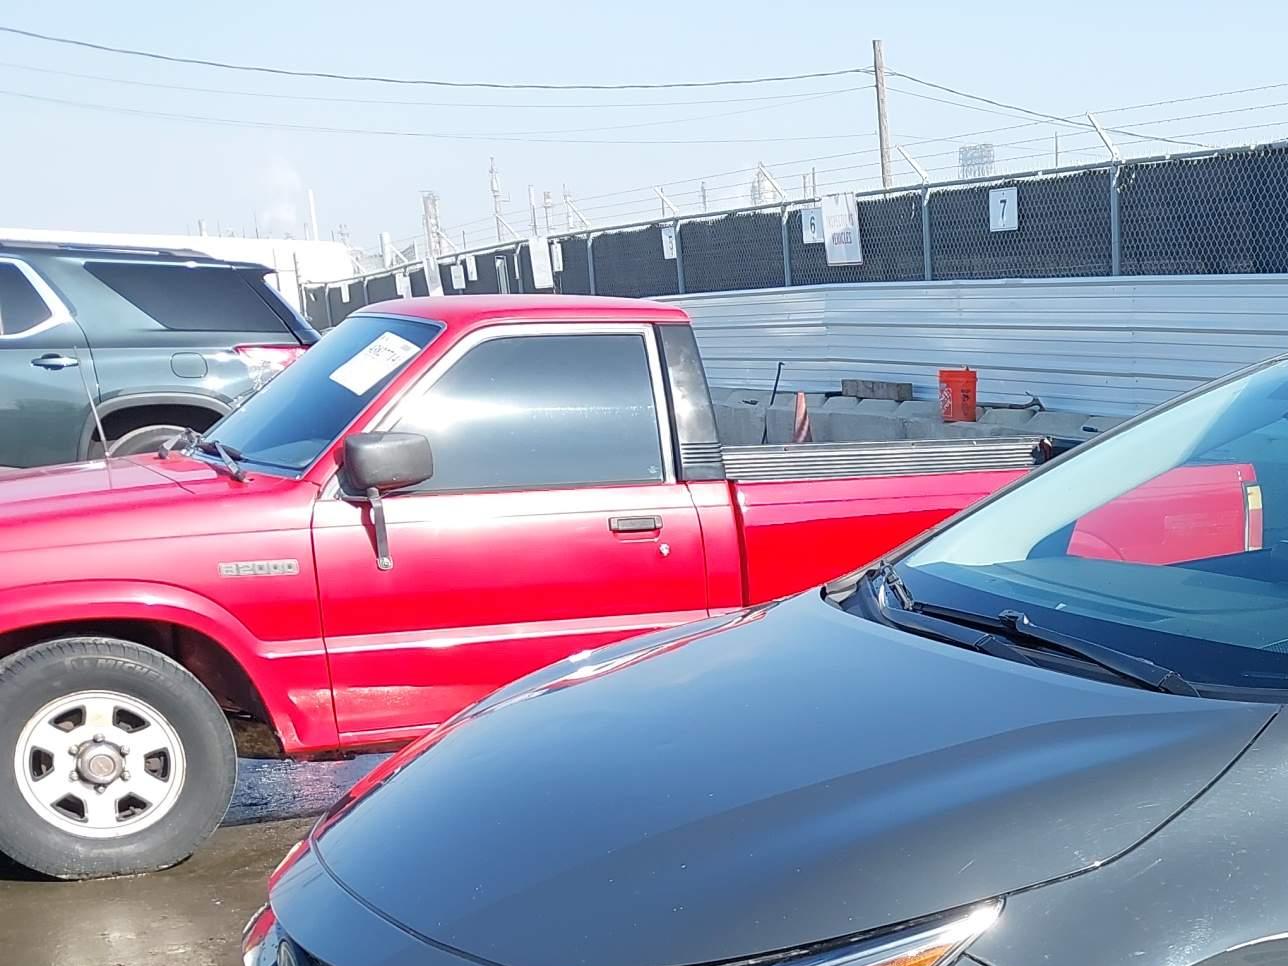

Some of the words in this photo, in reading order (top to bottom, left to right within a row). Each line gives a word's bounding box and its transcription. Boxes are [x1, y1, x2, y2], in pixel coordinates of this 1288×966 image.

[999, 199, 1007, 220] 7
[809, 215, 816, 234] 6
[222, 561, 297, 577] B2000
